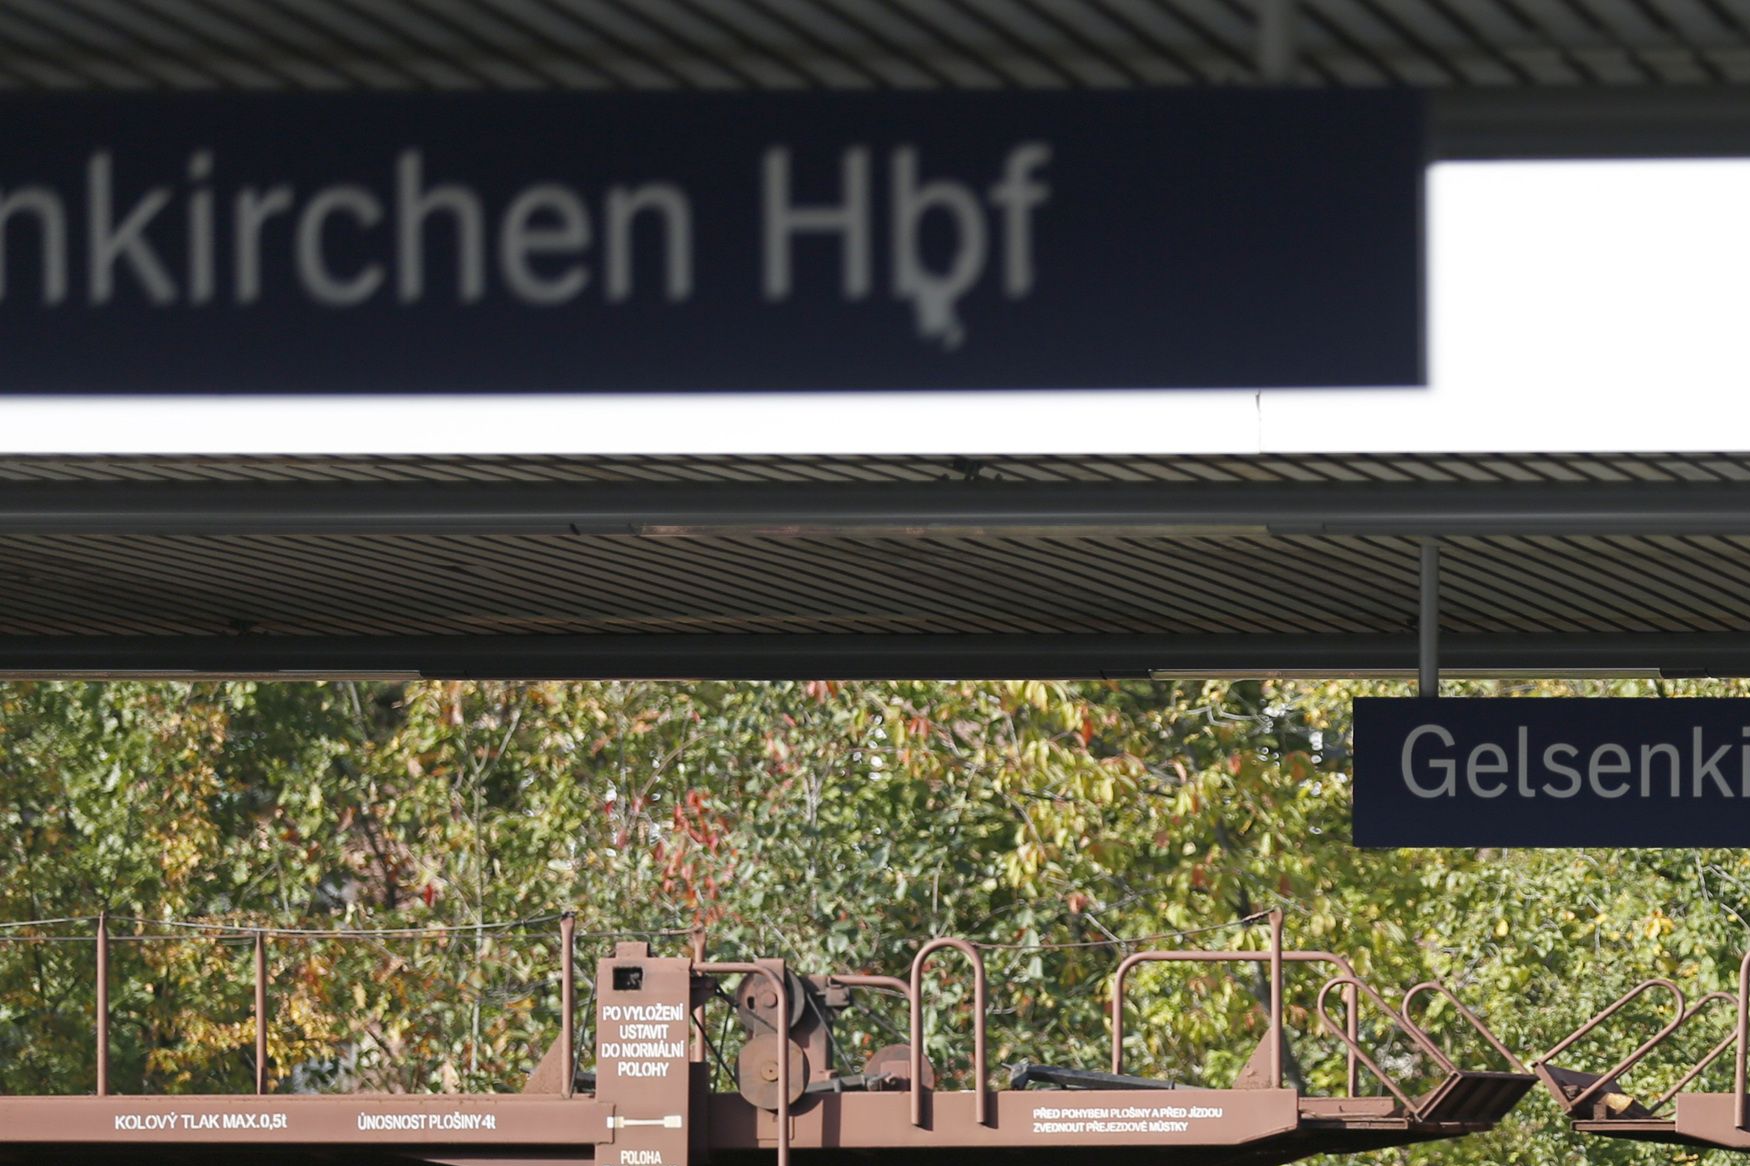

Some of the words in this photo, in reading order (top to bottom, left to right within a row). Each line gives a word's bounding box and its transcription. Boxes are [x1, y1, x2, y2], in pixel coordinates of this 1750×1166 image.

[762, 143, 1050, 303] Hbf
[603, 1005, 621, 1021] PO
[623, 1002, 684, 1021] VYLOŽENÍ
[619, 1024, 669, 1040] USTAVIT
[601, 1042, 620, 1058] DO
[622, 1039, 685, 1058] NORMÁLNÍ
[618, 1062, 669, 1077] POLOHY
[114, 1111, 178, 1130] KOLOVÝ
[181, 1115, 219, 1129] TLAK
[357, 1111, 426, 1131] ÚNOSNOST
[428, 1111, 482, 1130] PLOŠINY
[1061, 1108, 1109, 1119] POHYBEM
[1033, 1122, 1085, 1133] ZVEDNOUT
[620, 1150, 662, 1165] POLOHA
